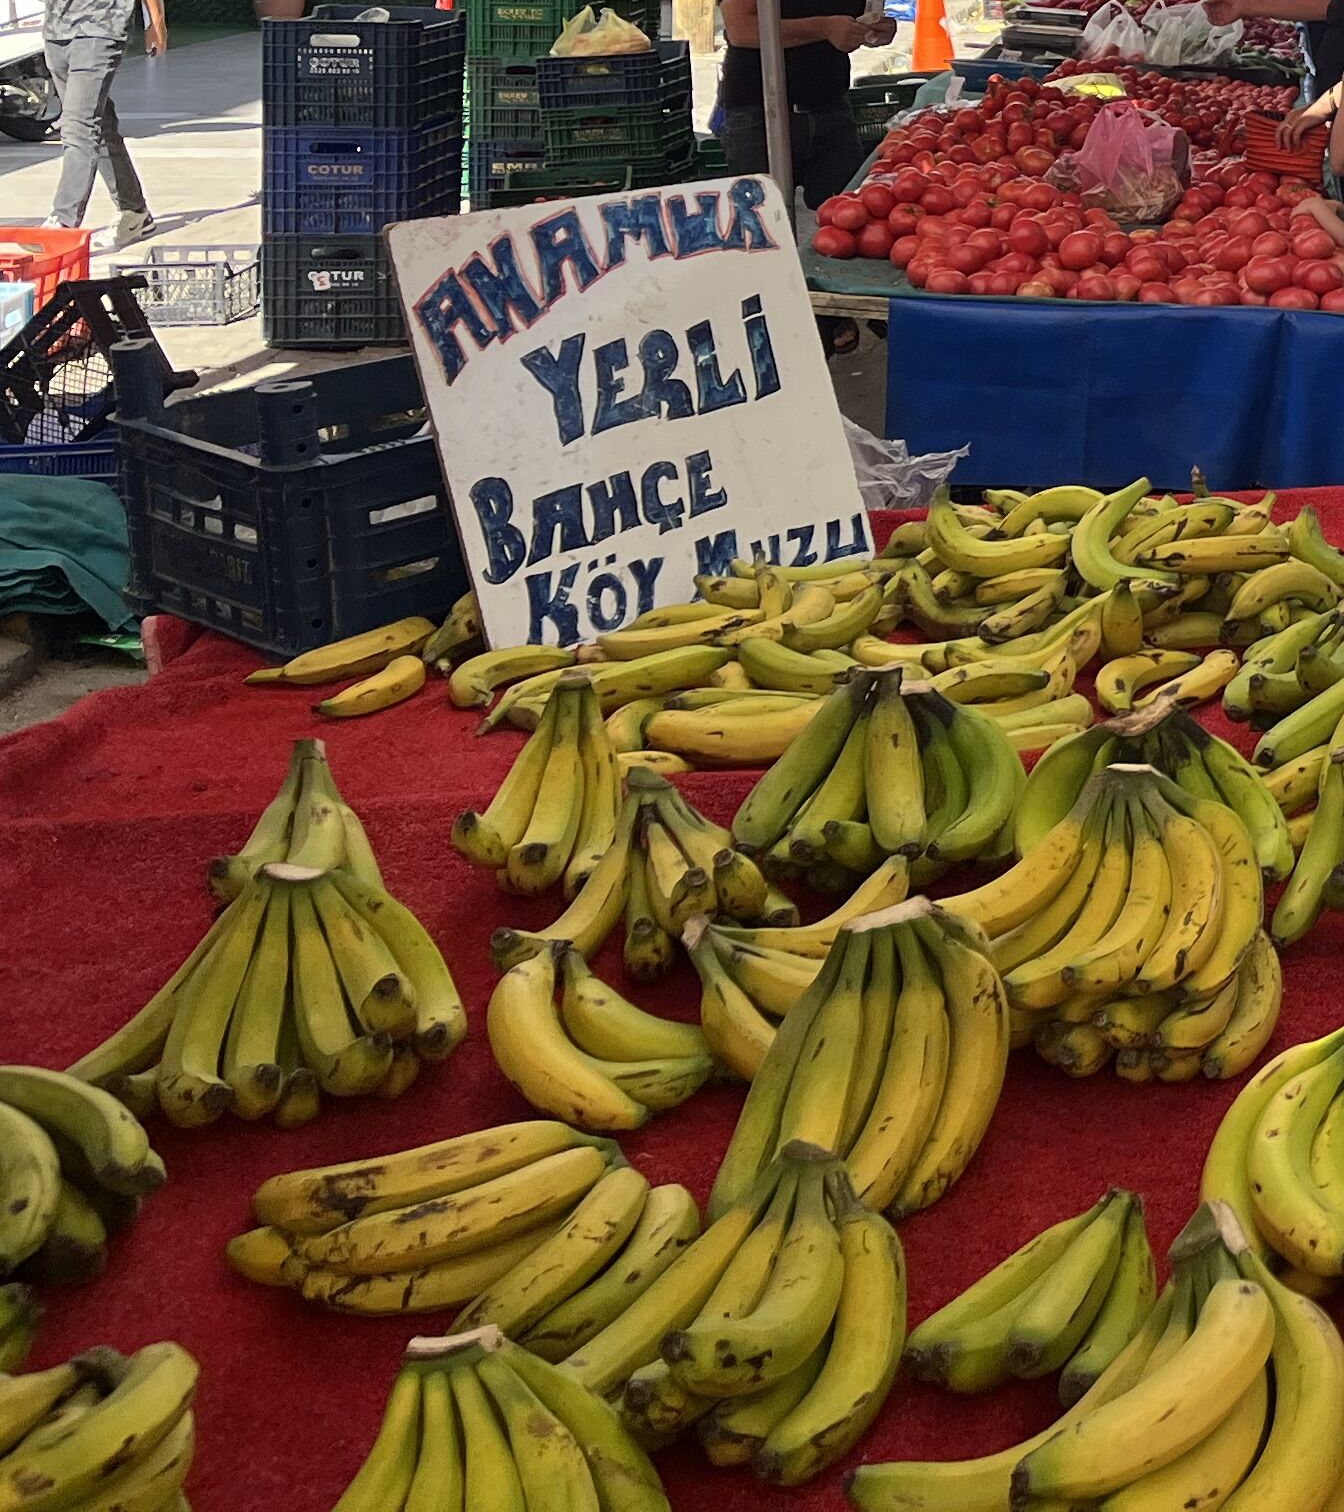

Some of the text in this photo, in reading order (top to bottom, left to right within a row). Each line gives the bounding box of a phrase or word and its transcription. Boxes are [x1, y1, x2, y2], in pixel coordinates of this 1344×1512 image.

[307, 164, 364, 175] COTUR
[413, 178, 780, 386] ANAMUR
[521, 294, 782, 446] YERLİ
[469, 449, 728, 585] BAHÇE
[525, 553, 665, 646] KÖY
